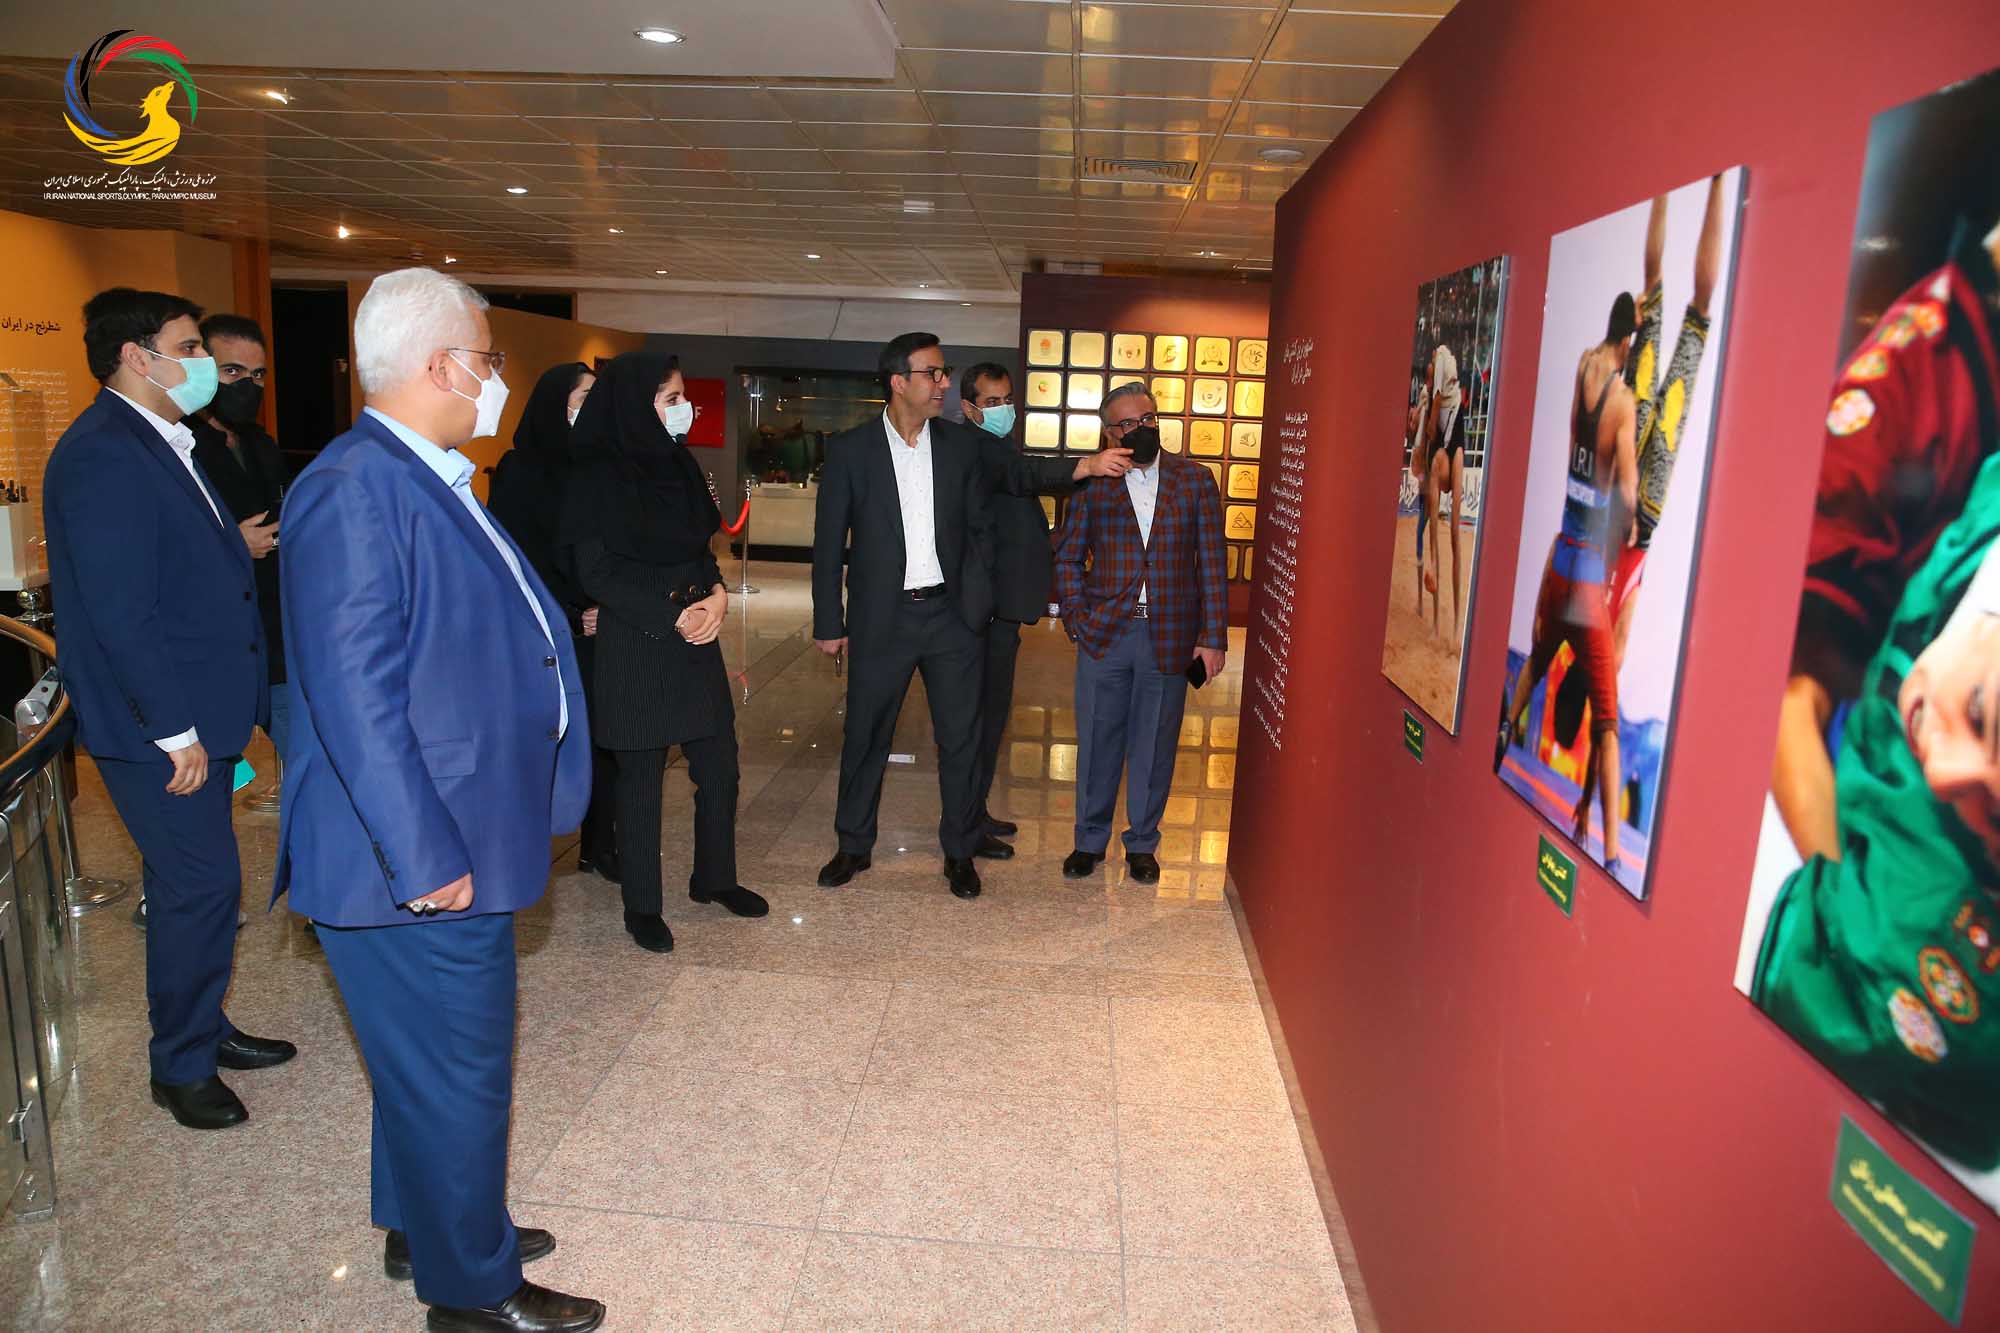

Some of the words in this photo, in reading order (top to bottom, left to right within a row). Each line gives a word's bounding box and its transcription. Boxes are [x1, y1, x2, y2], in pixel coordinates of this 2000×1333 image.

[1, 316, 22, 331] ایران
[24, 322, 34, 332] در
[36, 320, 61, 336] شطرنج
